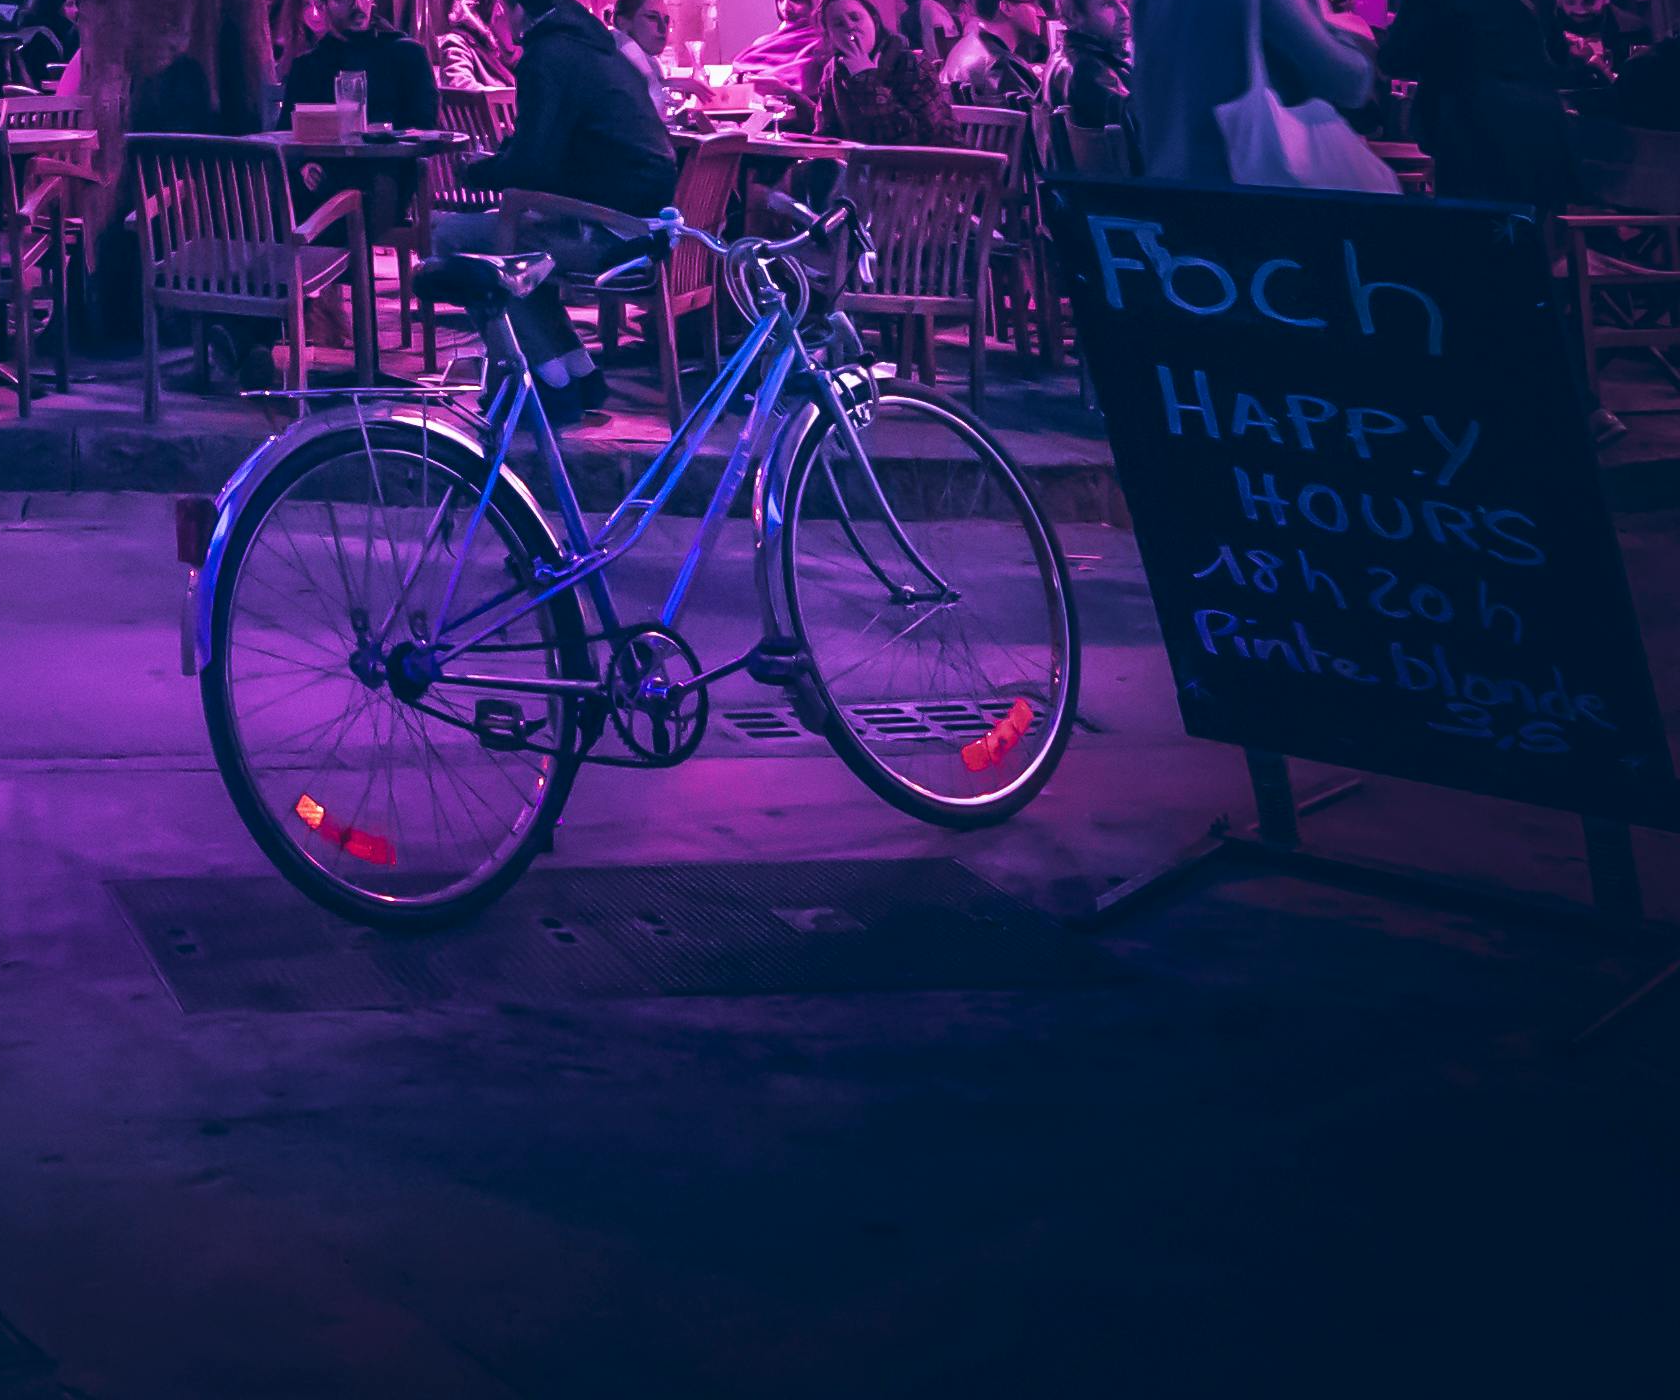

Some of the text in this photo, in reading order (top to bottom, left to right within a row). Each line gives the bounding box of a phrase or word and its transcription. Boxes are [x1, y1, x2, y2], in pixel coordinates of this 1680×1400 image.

[1086, 215, 1443, 356] Foch
[1156, 365, 1479, 486] HAPPY
[1233, 466, 1547, 566] HOURS
[1192, 608, 1617, 731] Pinte blonde
